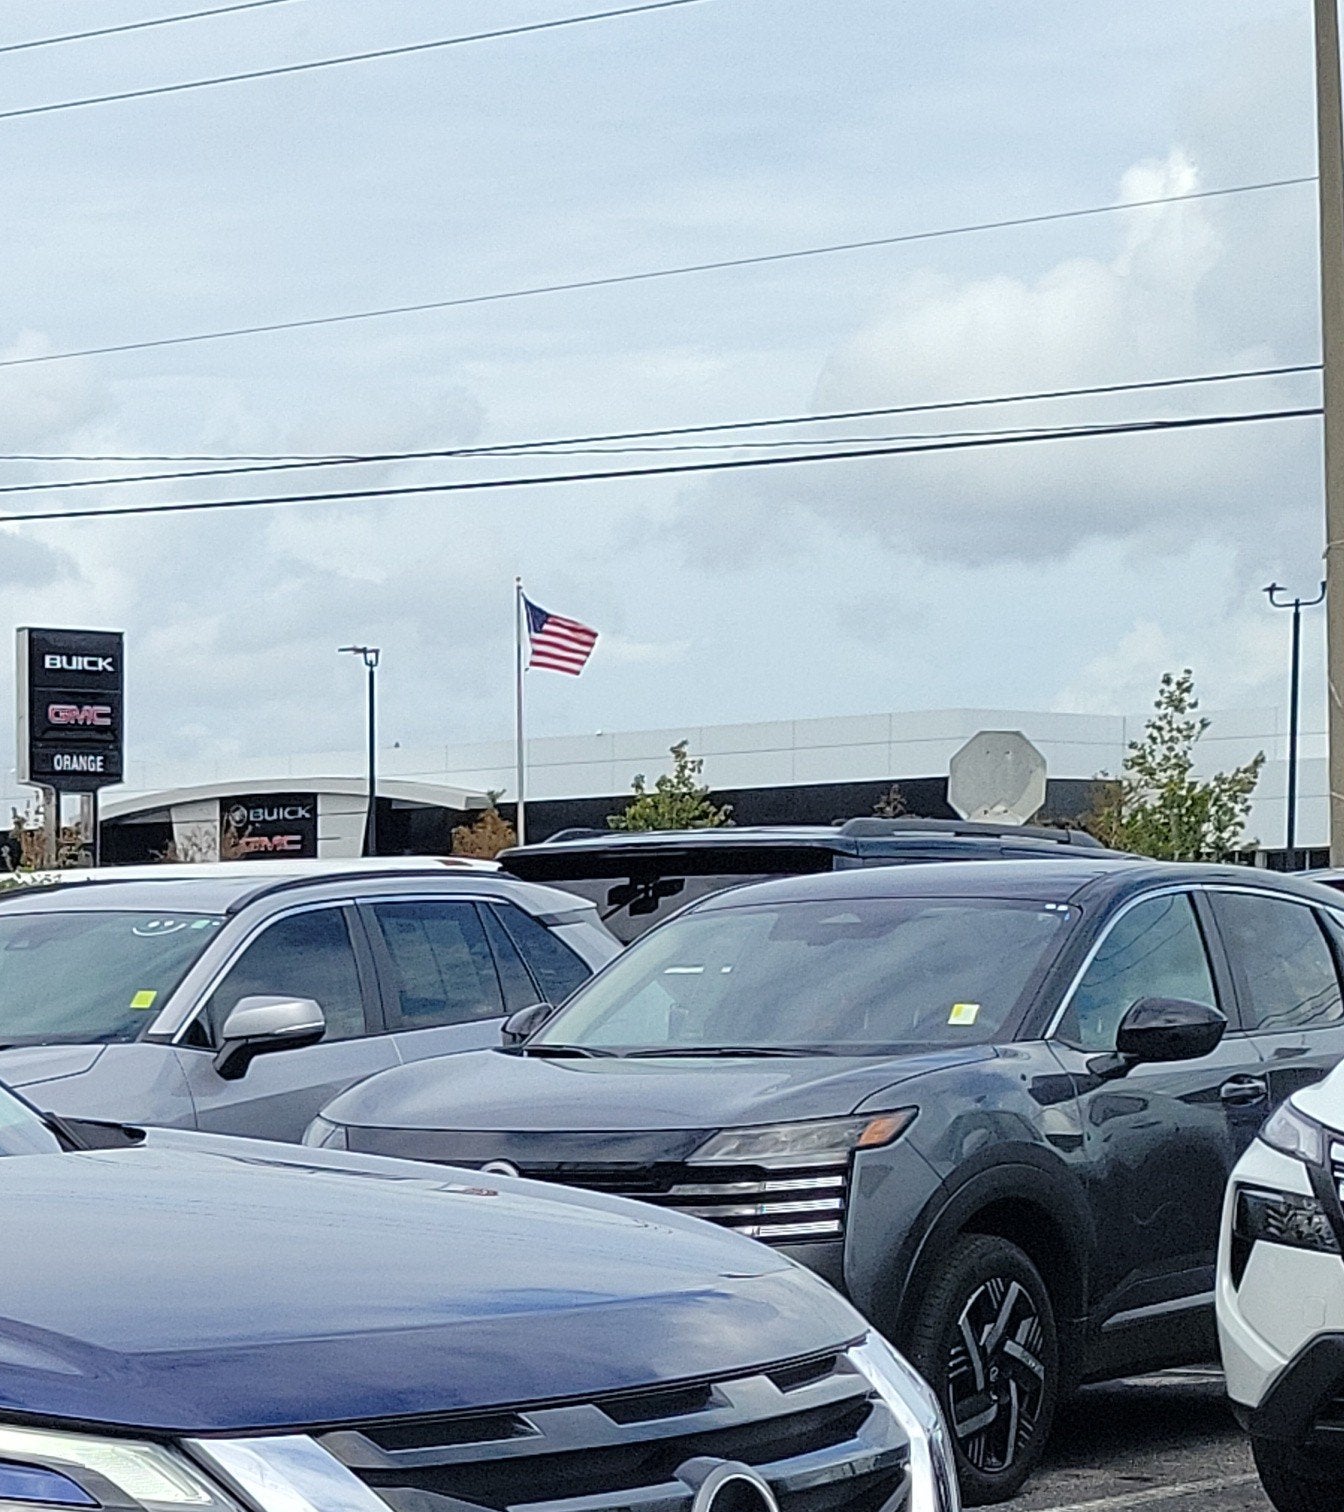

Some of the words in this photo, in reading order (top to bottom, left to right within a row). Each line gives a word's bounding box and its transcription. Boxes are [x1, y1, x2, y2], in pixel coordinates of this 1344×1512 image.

[44, 655, 114, 671] BUICK
[48, 704, 111, 726] GMC
[53, 754, 104, 772] ORANGE
[249, 805, 312, 821] BUICK
[238, 835, 302, 853] GMC
